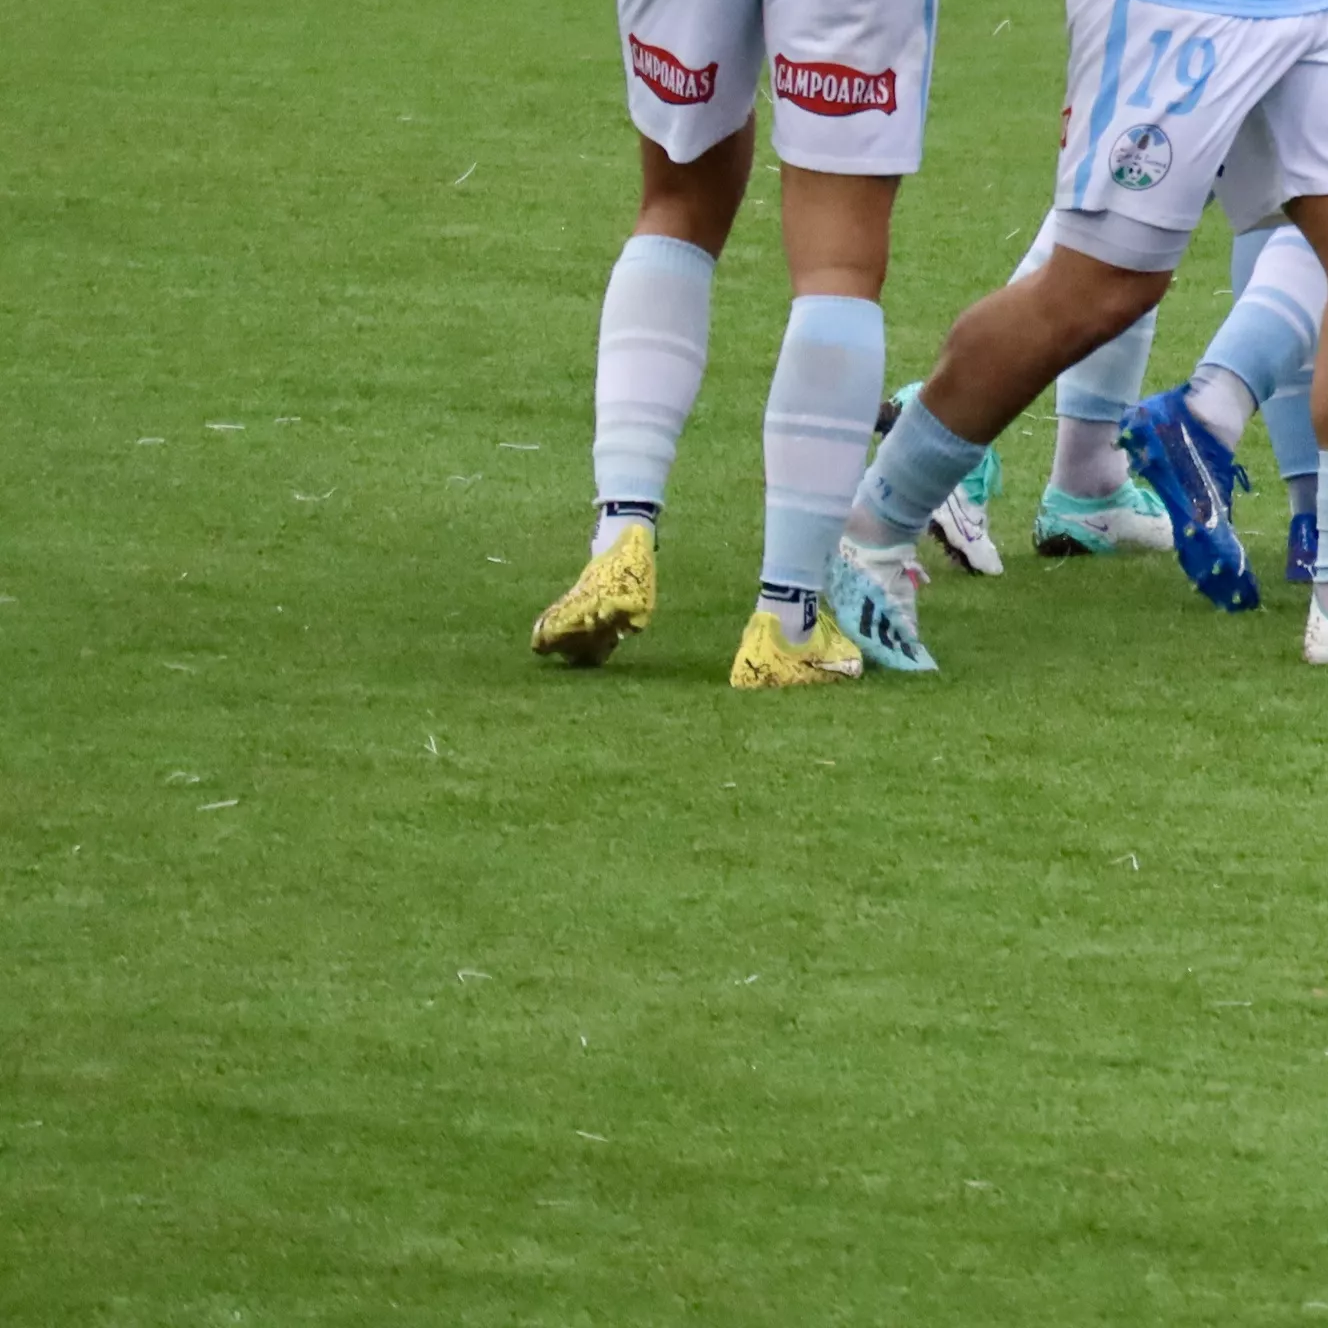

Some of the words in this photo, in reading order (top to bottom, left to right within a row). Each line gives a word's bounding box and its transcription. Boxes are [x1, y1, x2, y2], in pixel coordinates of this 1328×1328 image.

[632, 42, 710, 98] CAMPOARAS
[776, 62, 890, 105] CAMPOARAS
[1125, 28, 1217, 116] 19
